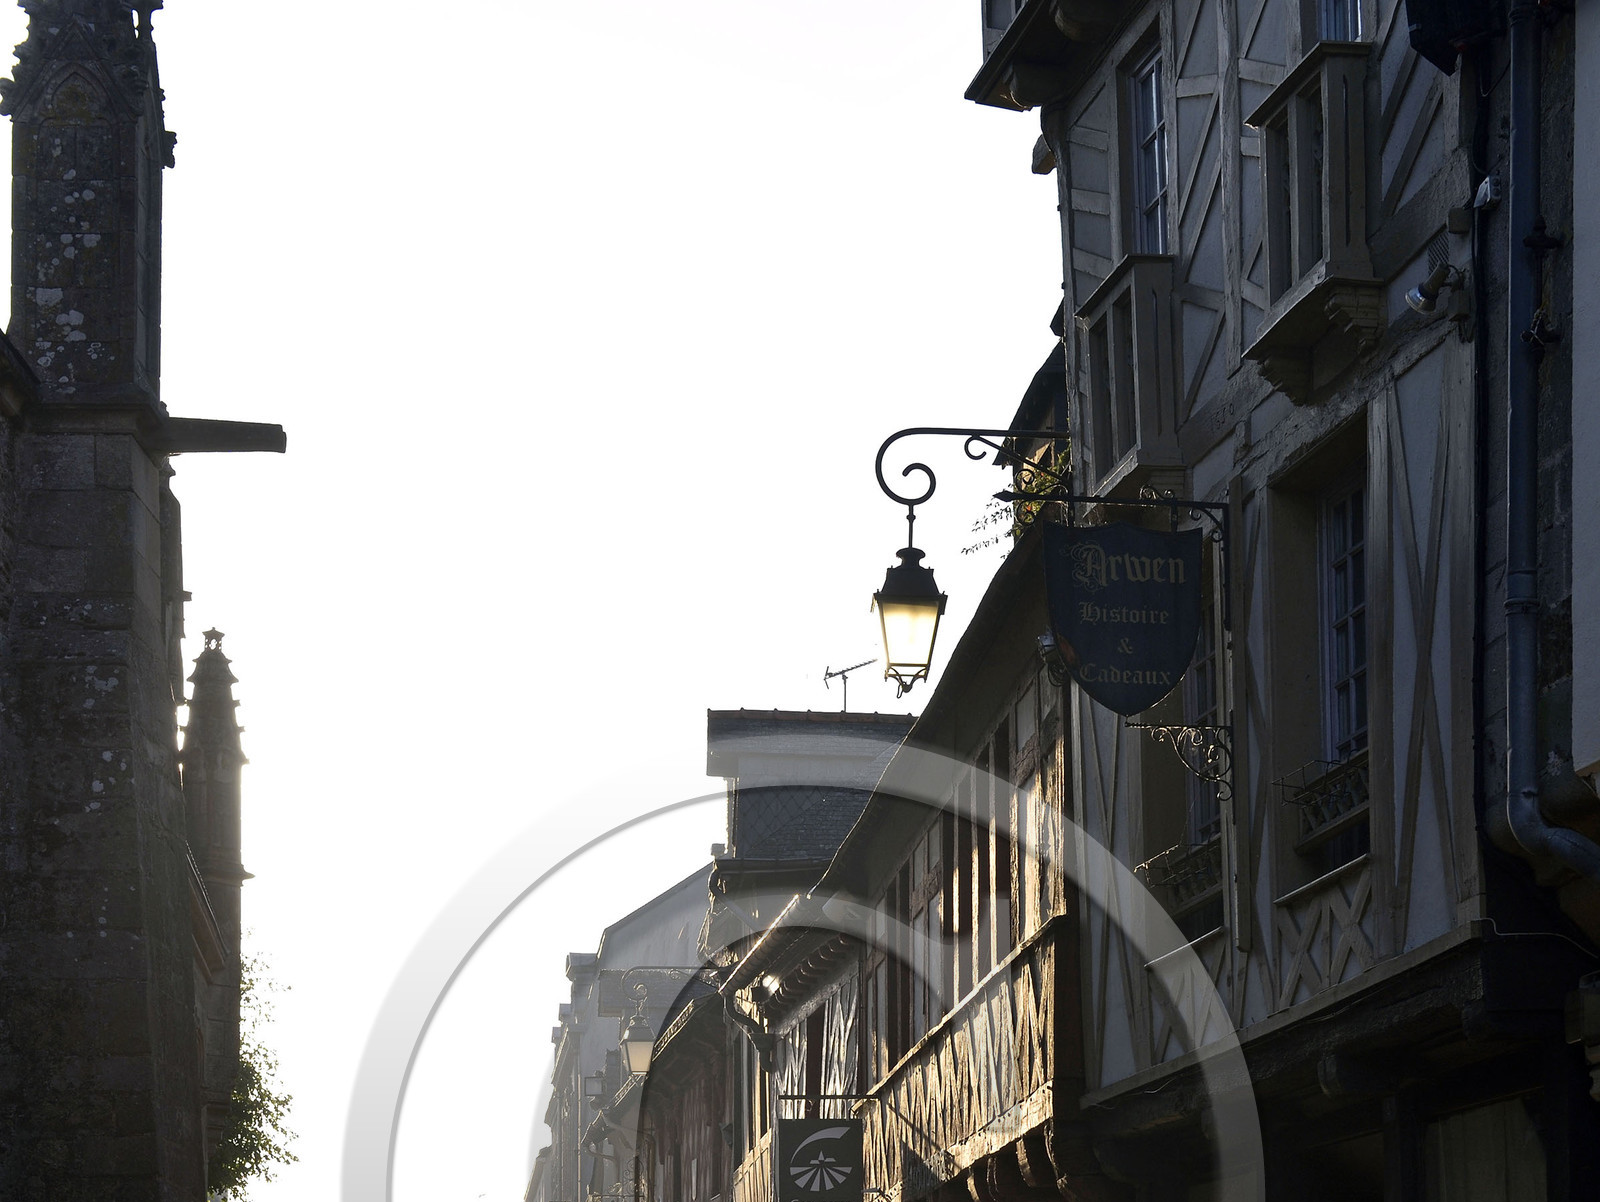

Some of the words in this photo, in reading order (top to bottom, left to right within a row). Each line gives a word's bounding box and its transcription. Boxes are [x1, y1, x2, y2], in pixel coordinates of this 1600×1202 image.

[1061, 540, 1187, 593] Arwen
[1078, 601, 1169, 625] Histoire
[1117, 637, 1133, 655] &
[1079, 663, 1171, 685] Cadeaux
